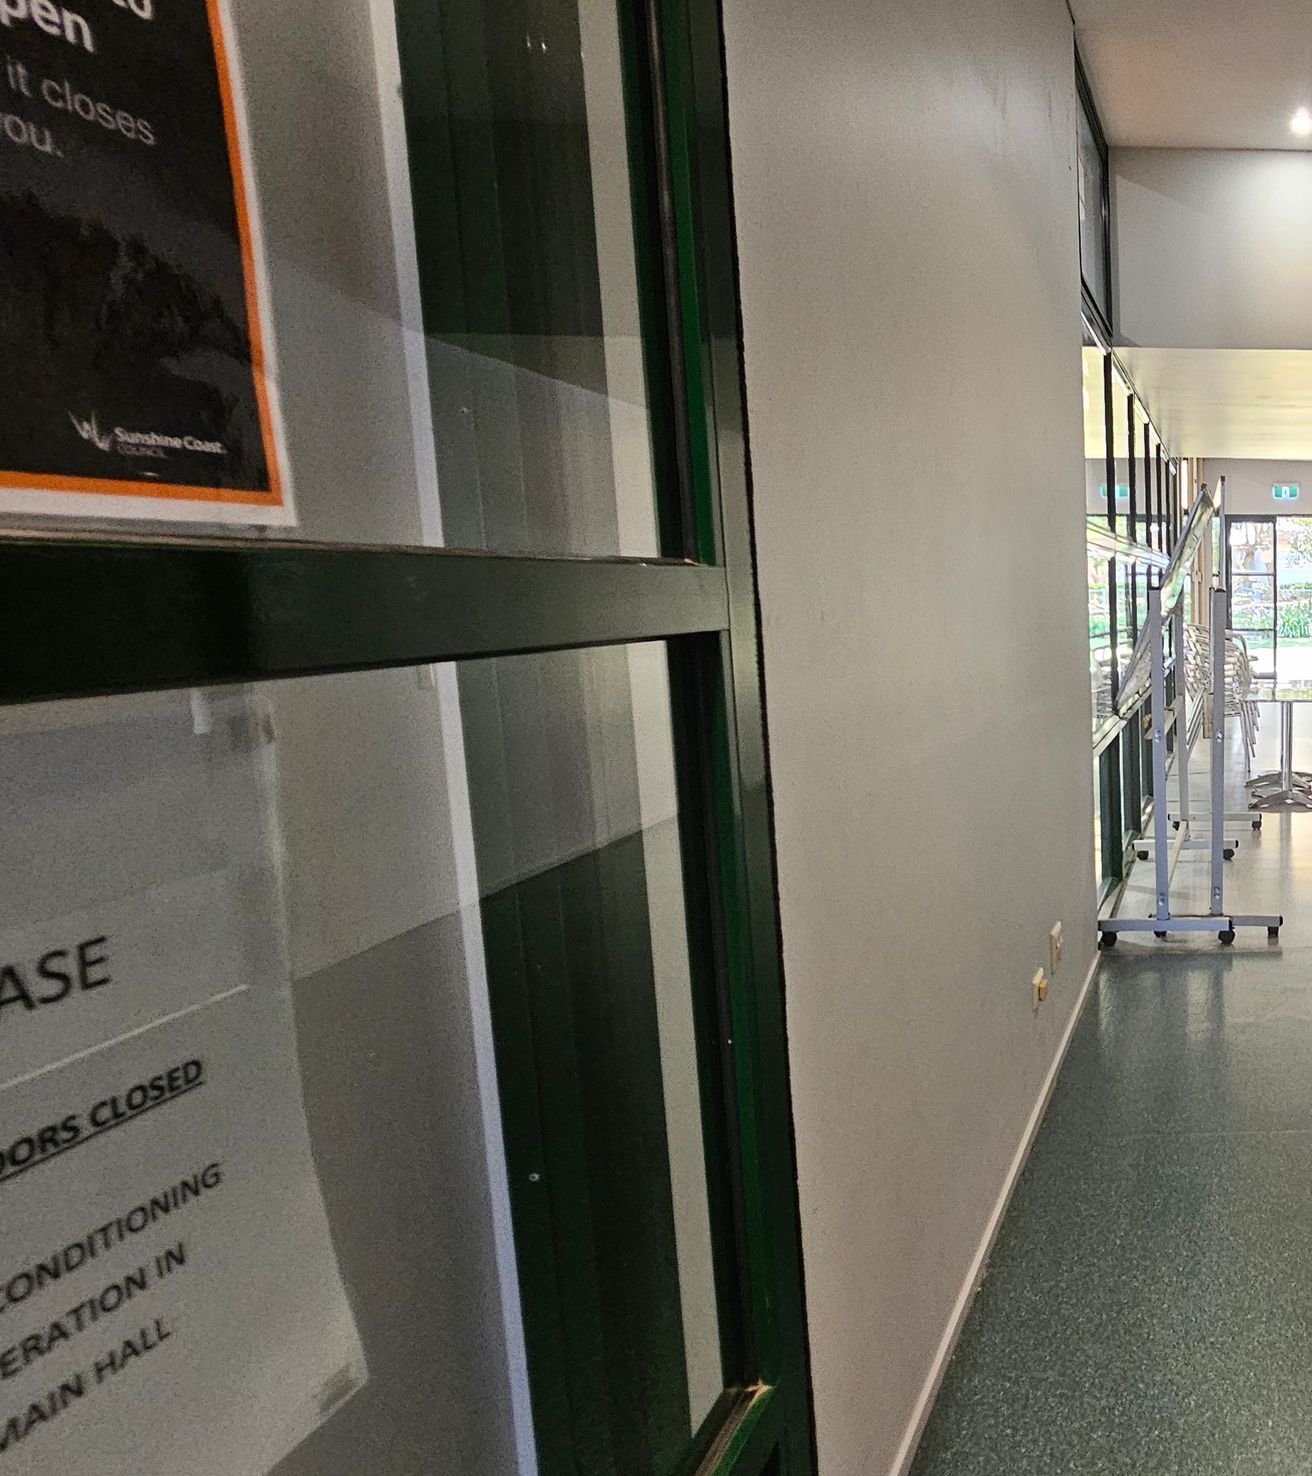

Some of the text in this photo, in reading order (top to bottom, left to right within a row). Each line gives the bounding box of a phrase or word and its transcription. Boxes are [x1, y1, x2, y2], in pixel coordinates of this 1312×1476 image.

[6, 54, 156, 145] it closes
[0, 113, 64, 158] ou.
[114, 427, 183, 448] Sunshine
[0, 935, 111, 1010] ASE
[0, 1059, 203, 1175] ORS CLOSED
[155, 1241, 186, 1278] IN
[94, 1318, 172, 1384] HALL
